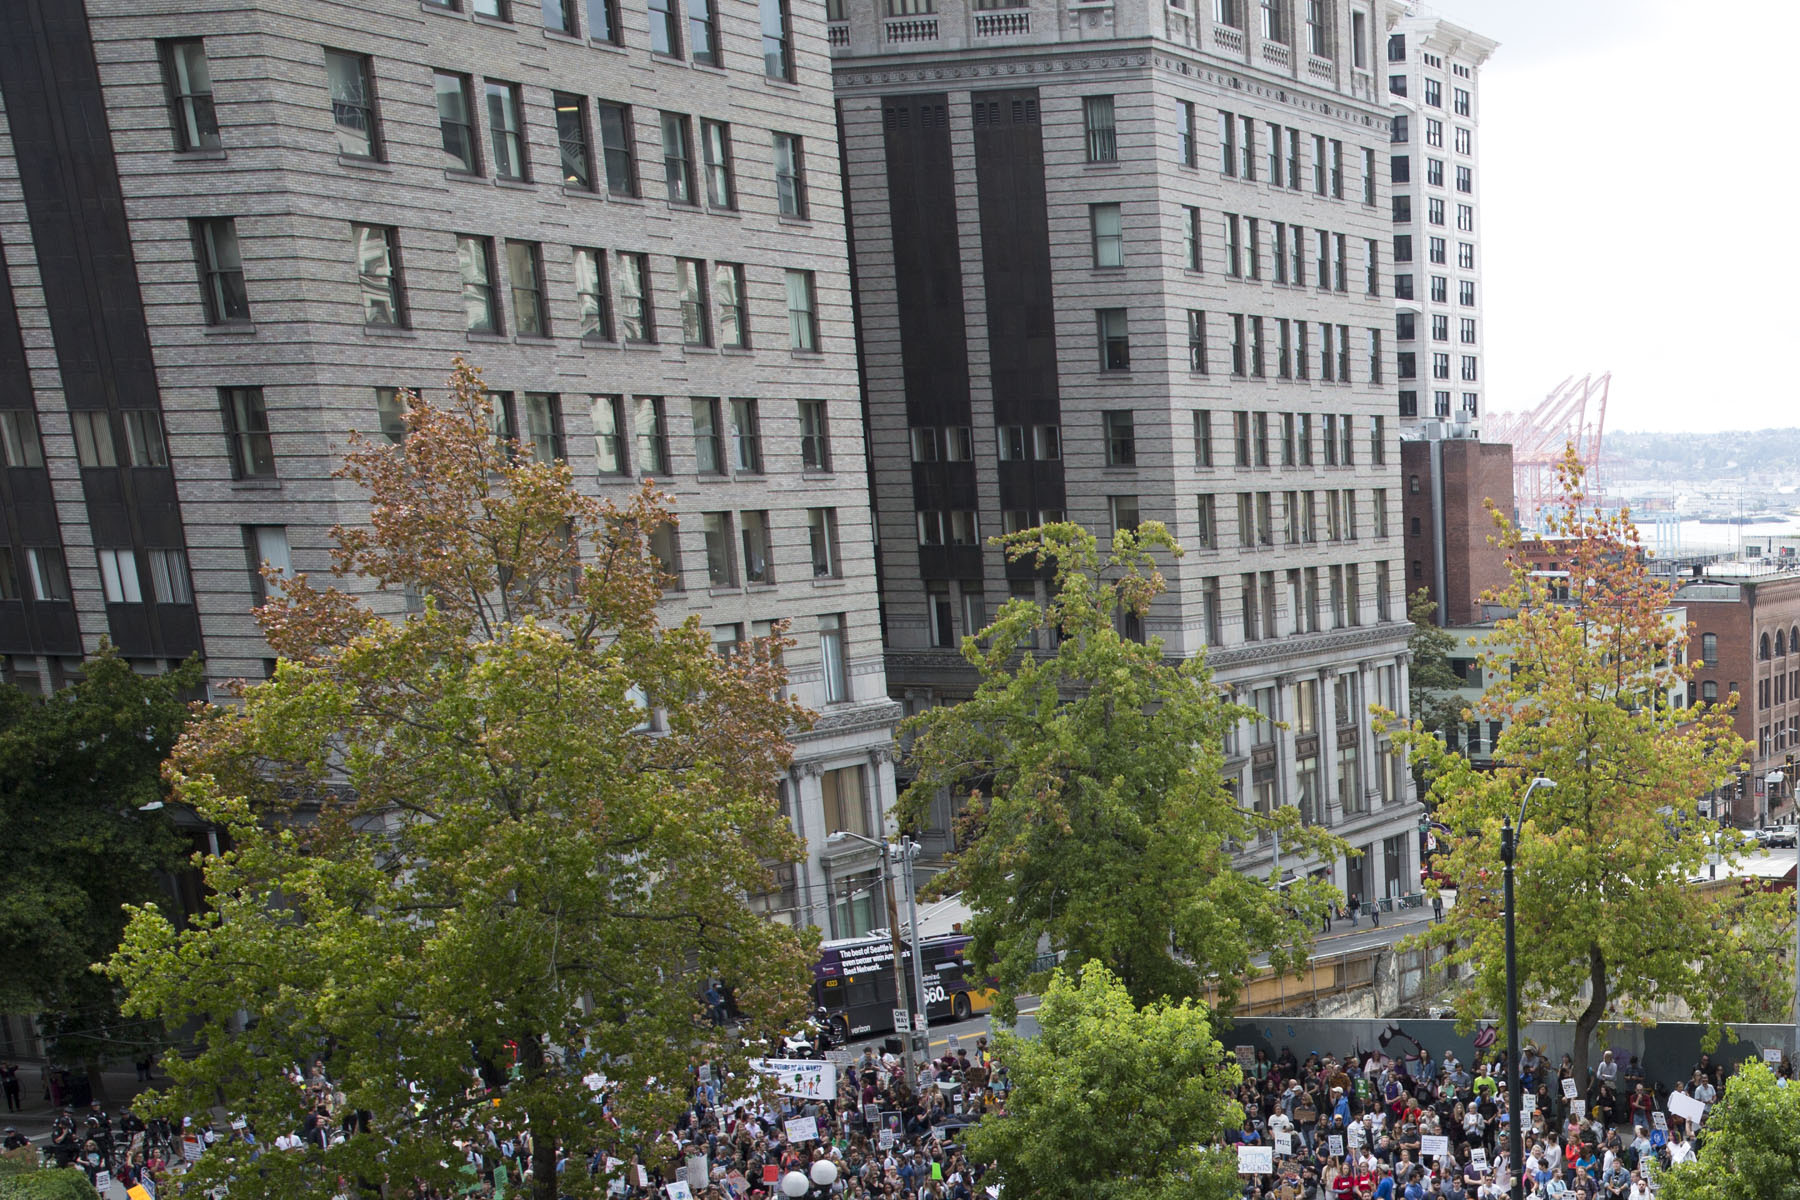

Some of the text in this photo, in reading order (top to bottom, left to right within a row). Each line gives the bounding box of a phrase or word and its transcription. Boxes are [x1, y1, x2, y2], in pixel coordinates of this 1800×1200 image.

[840, 948, 851, 959] The
[851, 947, 863, 957] best
[870, 944, 888, 955] Seattle
[856, 956, 872, 966] better
[843, 962, 883, 976] Best Network.
[850, 1024, 871, 1035] verizon
